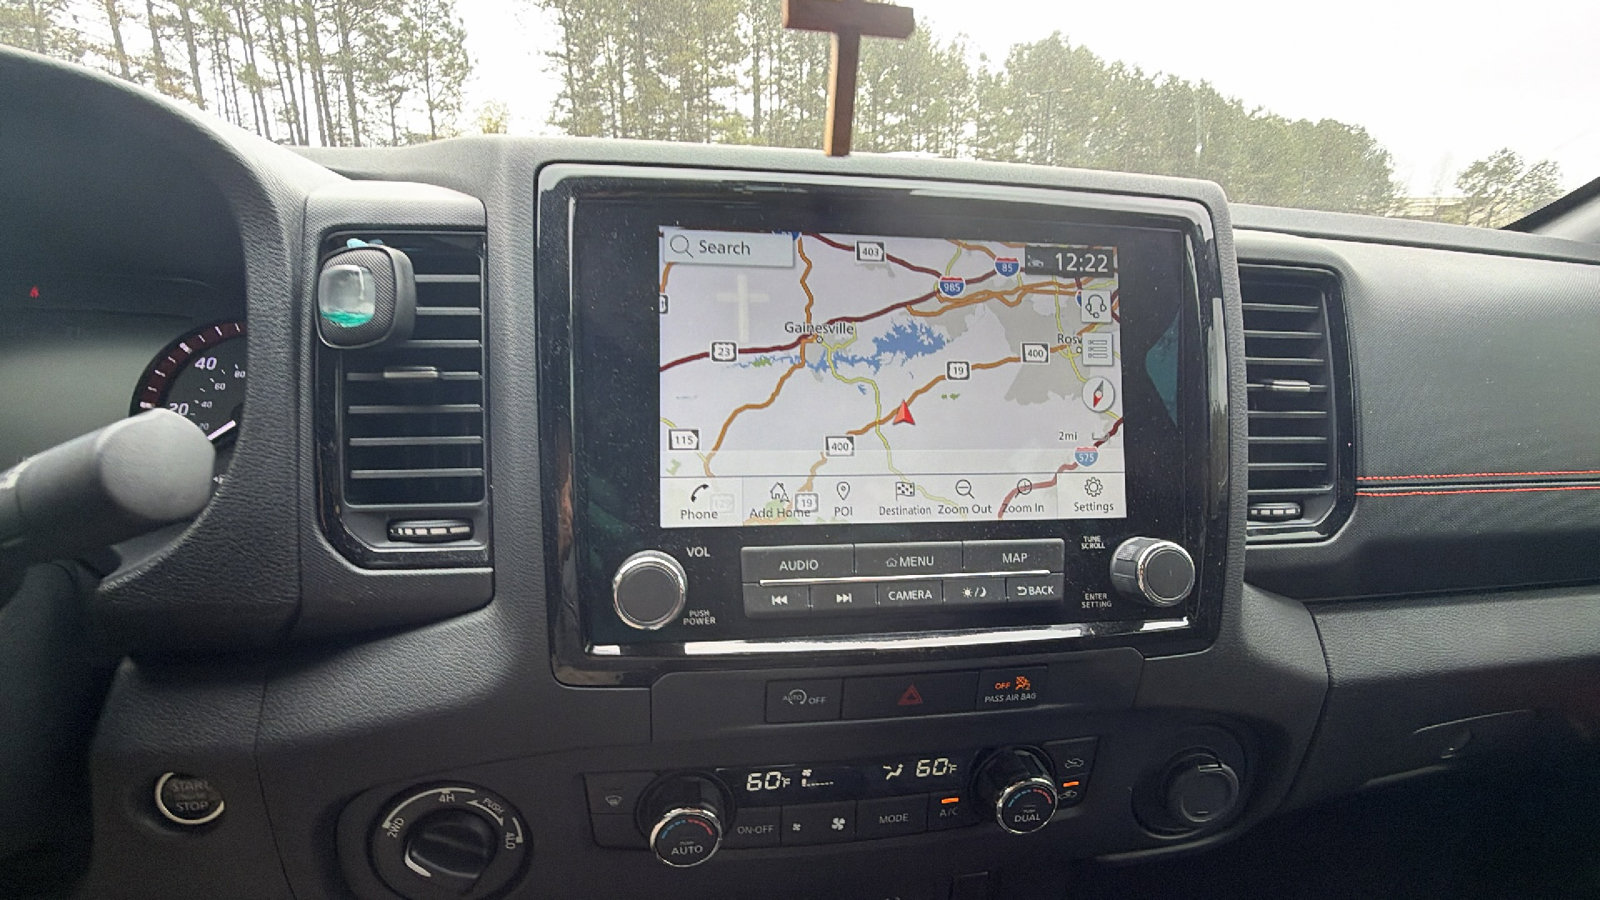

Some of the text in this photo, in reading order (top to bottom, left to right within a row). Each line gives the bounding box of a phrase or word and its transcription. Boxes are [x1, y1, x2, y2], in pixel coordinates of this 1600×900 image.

[699, 240, 751, 256] Search
[862, 247, 880, 257] 403
[1055, 252, 1109, 273] 12:22
[1001, 263, 1013, 273] 85
[943, 282, 961, 292] 985
[784, 321, 855, 336] Gainesville
[717, 346, 731, 357] 23
[1027, 348, 1044, 358] 400
[194, 356, 218, 371] 40
[234, 370, 246, 378] 80
[953, 366, 964, 376] 19
[214, 382, 226, 391] 60
[169, 402, 189, 416] 20
[675, 435, 694, 445] 115
[1058, 431, 1078, 441] 2mi
[831, 442, 849, 451] 400
[1078, 453, 1095, 462] 575
[802, 499, 813, 508] 19
[1002, 503, 1045, 513] Zoom In
[1073, 501, 1115, 514] Settings
[680, 508, 719, 520] Phone
[750, 507, 811, 519] Add Home
[834, 506, 853, 516] POI
[879, 505, 932, 515] Destination
[937, 504, 993, 515] Zoom Out
[1082, 535, 1101, 543] TUNE
[1081, 542, 1106, 550] SCROLL
[686, 546, 711, 558] VOL
[899, 556, 934, 568] MENU
[1002, 552, 1028, 563] MAP
[779, 559, 819, 571] AUDIO
[888, 589, 933, 601] CAMERA
[1028, 585, 1054, 596] BACK
[1084, 593, 1108, 601] ENTER
[1081, 600, 1112, 609] SETTING
[688, 609, 710, 617] PUSH
[683, 617, 716, 626] POWER
[994, 682, 1011, 690] OFF
[808, 696, 828, 705] OFF
[984, 692, 1037, 703] PASS AIR BAG
[438, 793, 456, 803] 4H
[176, 801, 210, 811] STOP
[482, 797, 505, 814] PUSH
[940, 806, 958, 817] A/C
[879, 812, 909, 824] MODE
[1014, 813, 1041, 823] DUAL
[388, 817, 405, 838] 2WD
[671, 844, 704, 856] AUTO
